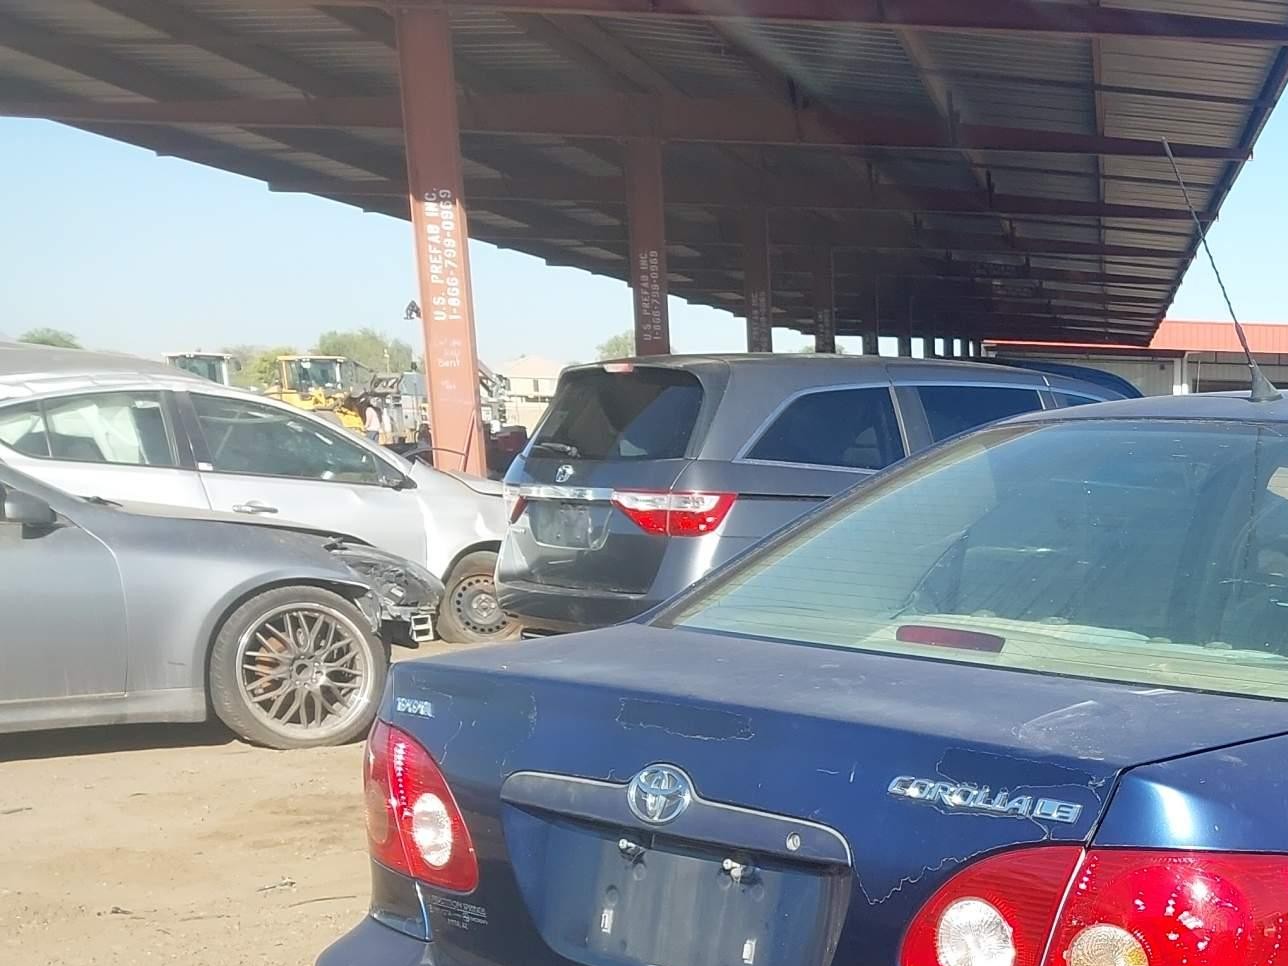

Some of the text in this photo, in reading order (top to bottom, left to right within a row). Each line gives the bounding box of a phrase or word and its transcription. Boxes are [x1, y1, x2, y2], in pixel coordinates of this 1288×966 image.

[423, 187, 448, 321] U.S. PREFAB INC.
[887, 776, 1083, 824] COROLLA LE
